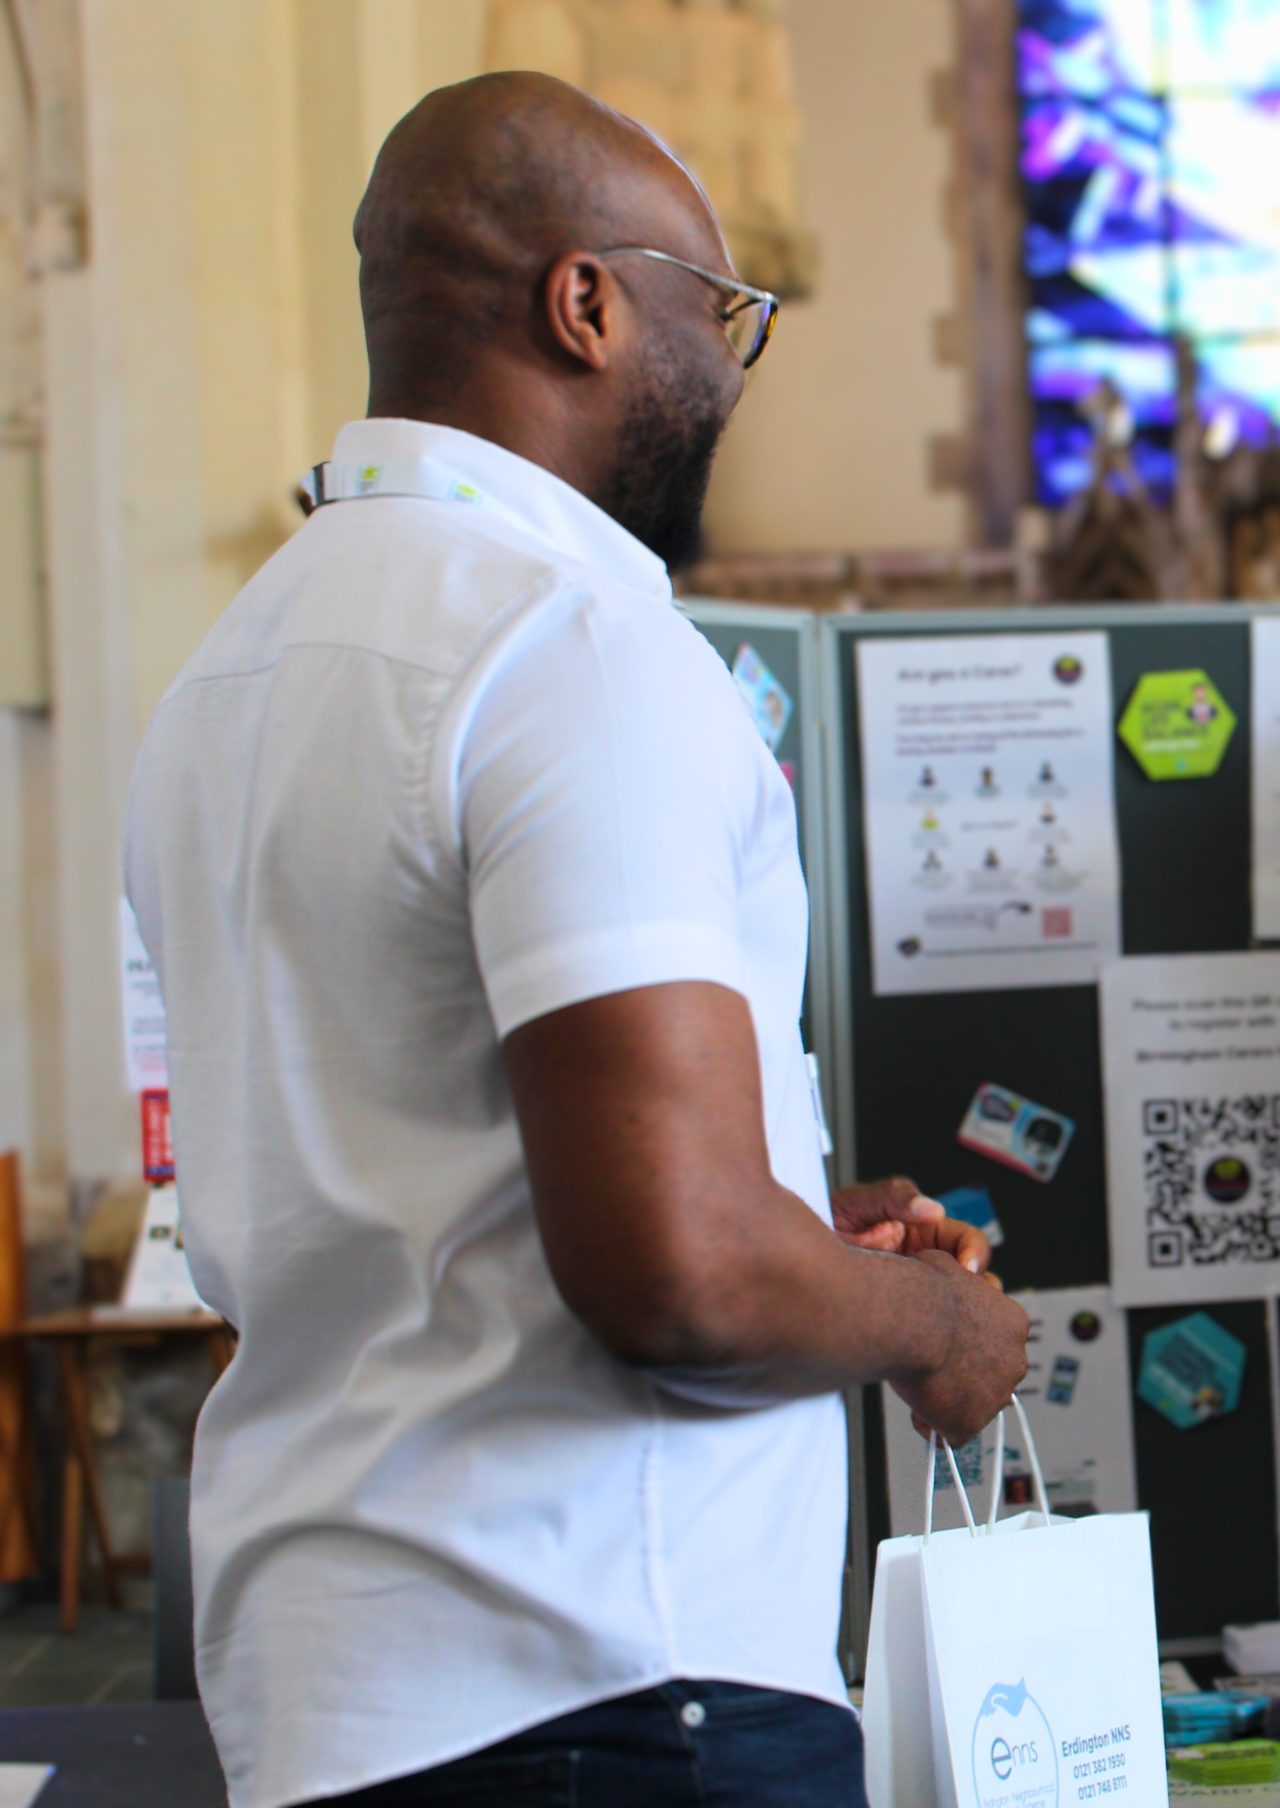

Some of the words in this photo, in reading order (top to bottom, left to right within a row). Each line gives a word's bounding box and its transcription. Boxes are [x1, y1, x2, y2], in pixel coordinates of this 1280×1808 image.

[1061, 1730, 1110, 1758] Erdington
[1111, 1724, 1132, 1746] NNS
[1073, 1761, 1092, 1780] 0121
[1093, 1757, 1108, 1775] 382
[1108, 1752, 1126, 1771] 1930
[1077, 1782, 1096, 1801] 0121
[1097, 1779, 1112, 1796] 748
[1112, 1775, 1128, 1793] 8111
